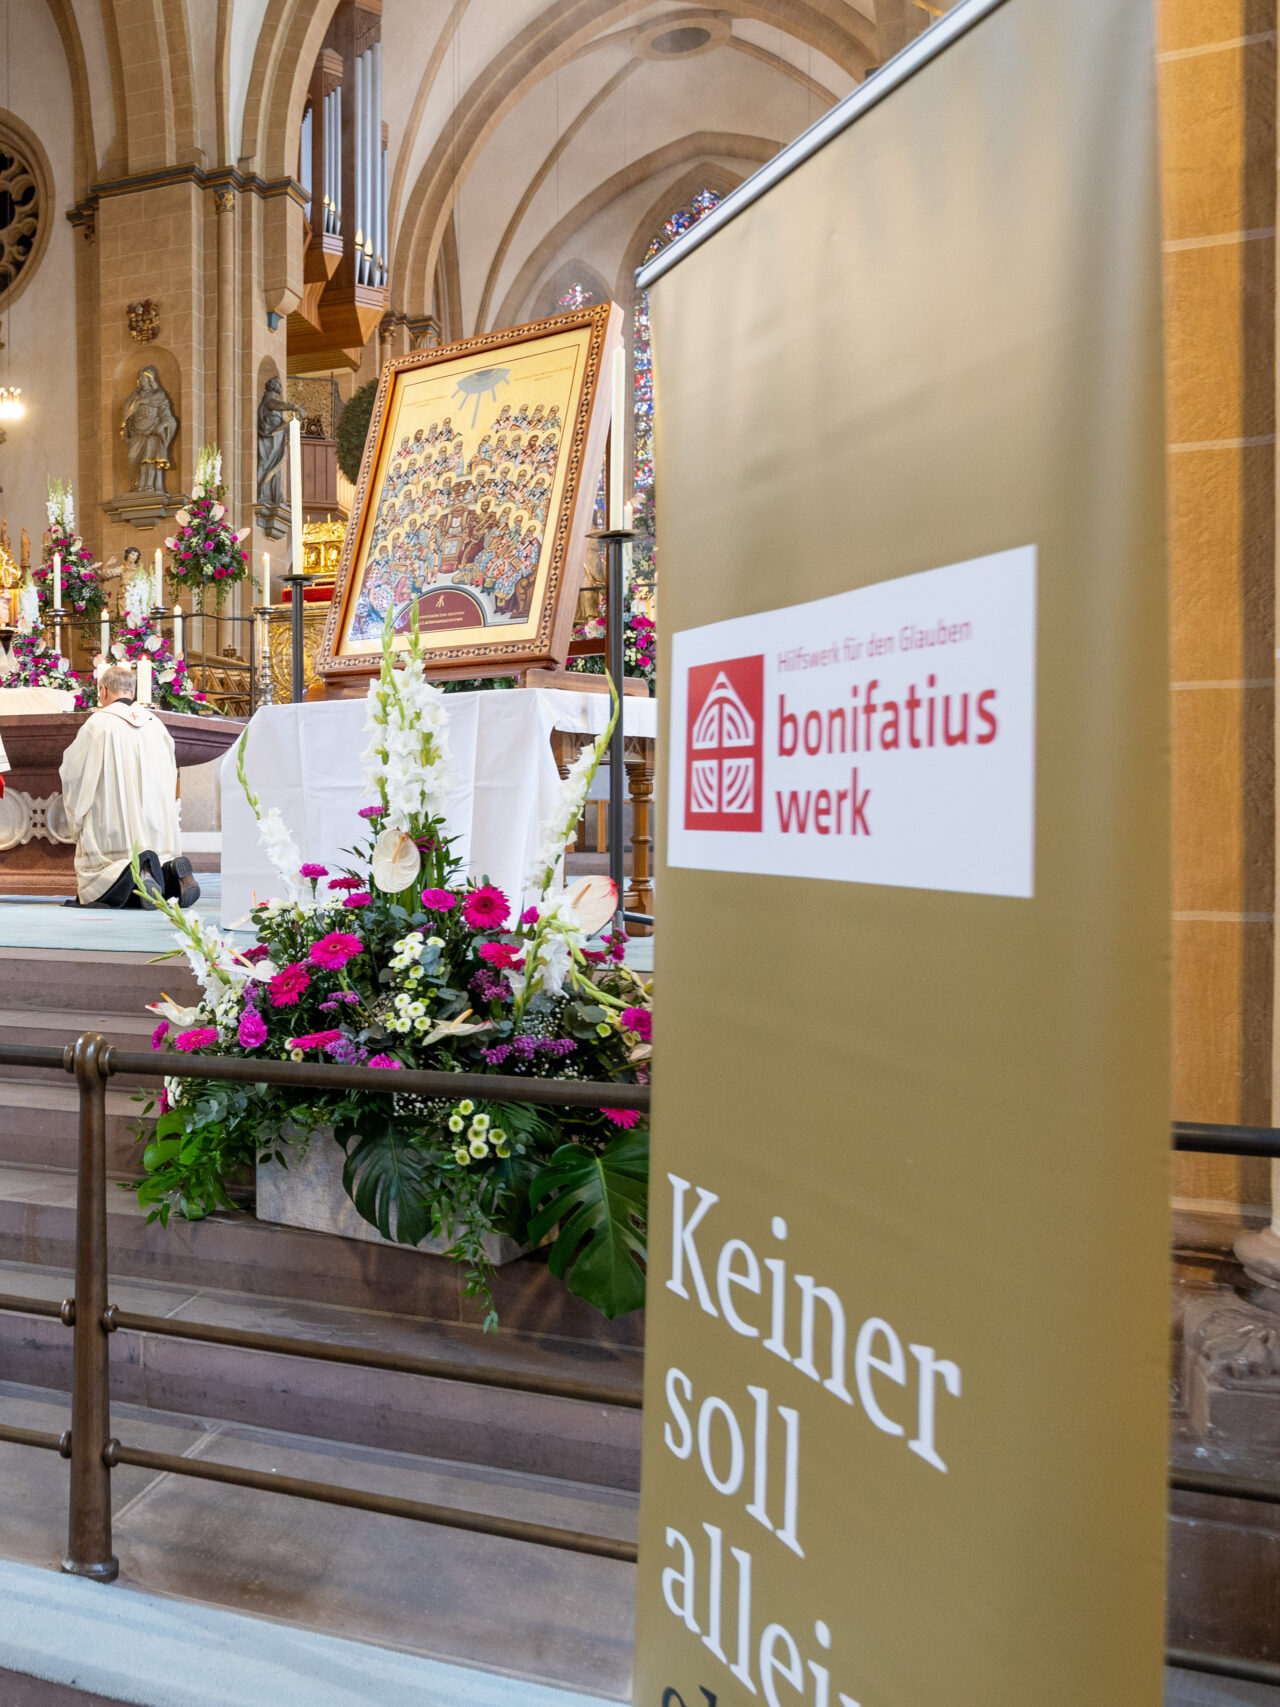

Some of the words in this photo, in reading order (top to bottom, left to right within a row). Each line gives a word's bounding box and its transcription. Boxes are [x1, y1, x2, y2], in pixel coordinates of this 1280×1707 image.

[777, 641, 839, 673] Hilfswerk
[843, 636, 863, 661] für
[866, 632, 895, 657] den
[899, 618, 972, 652] Glauben
[777, 674, 998, 757] bonifatius
[776, 767, 871, 836] werk
[665, 1172, 962, 1473] Keiner
[664, 1367, 805, 1558] soll
[661, 1522, 862, 1707] allei
